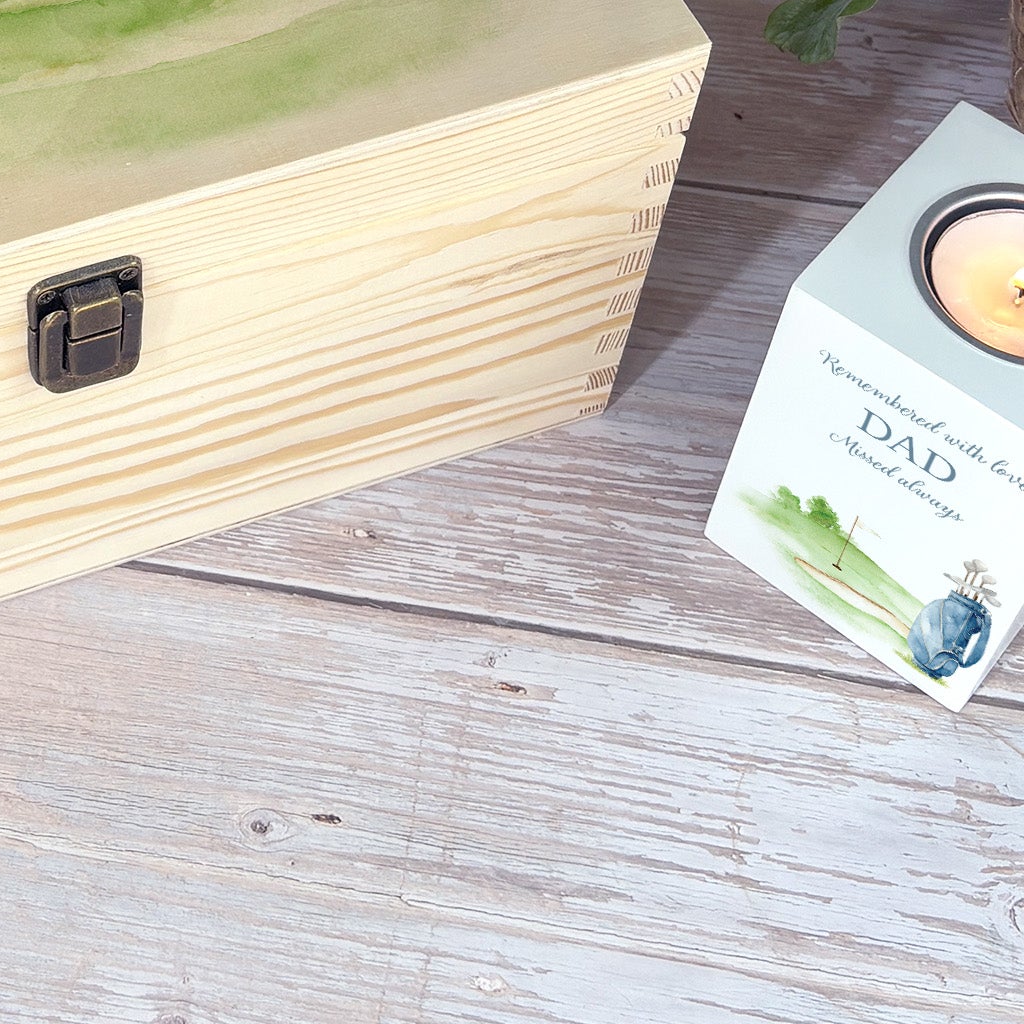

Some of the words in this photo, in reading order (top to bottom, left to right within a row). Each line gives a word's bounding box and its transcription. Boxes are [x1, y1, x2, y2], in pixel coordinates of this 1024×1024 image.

[819, 349, 947, 435] Remembered
[944, 433, 988, 464] with
[857, 407, 957, 483] DAD
[829, 431, 896, 479] Missed
[897, 477, 964, 522] always
